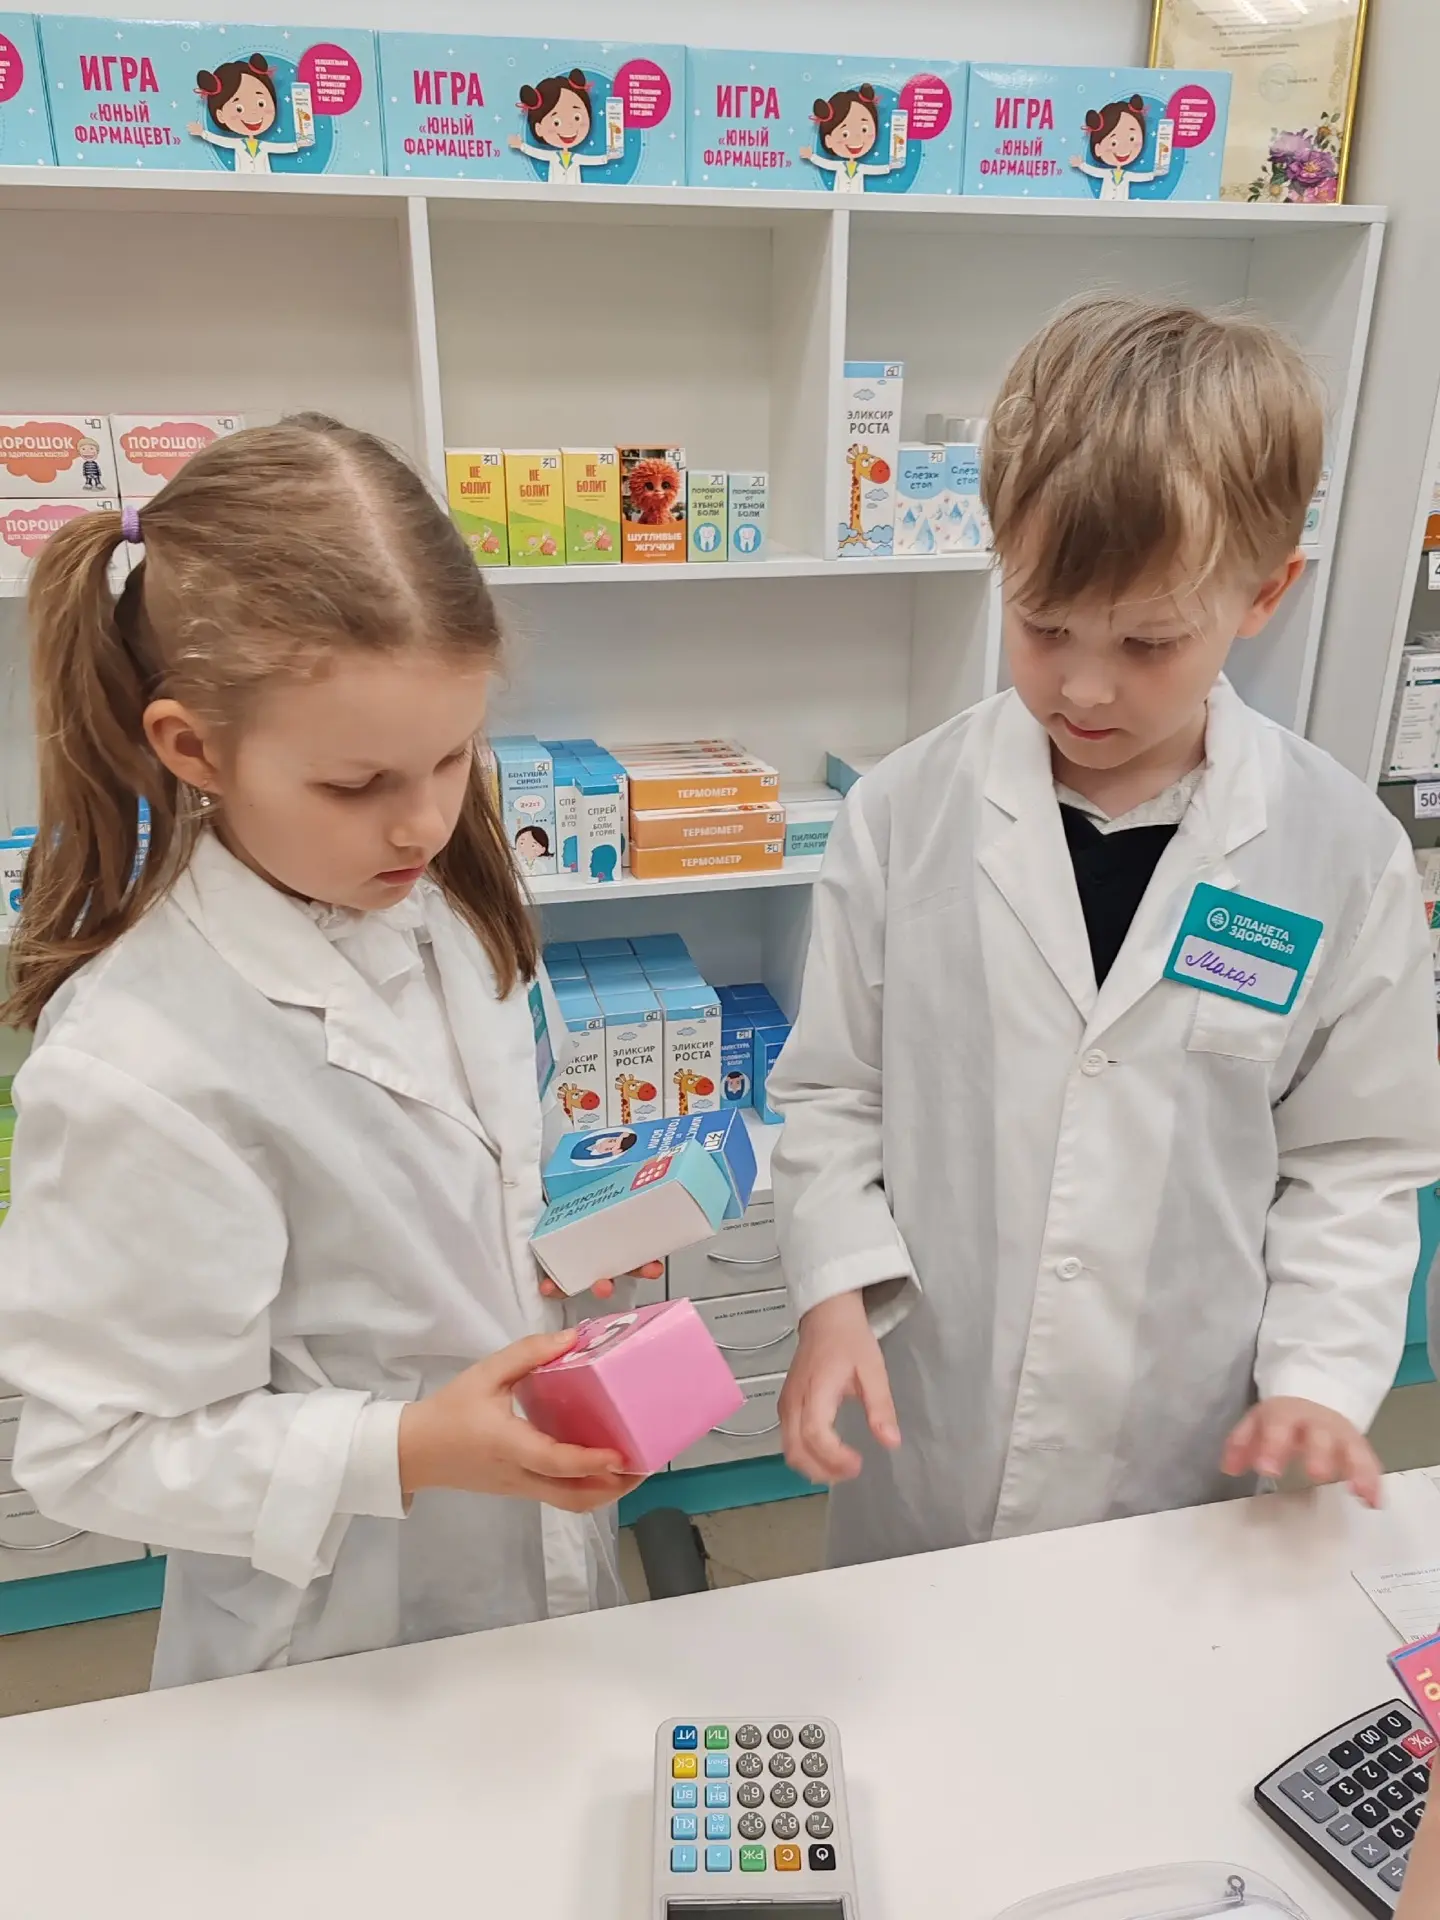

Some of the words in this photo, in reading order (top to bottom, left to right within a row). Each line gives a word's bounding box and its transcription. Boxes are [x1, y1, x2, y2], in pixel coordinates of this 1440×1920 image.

[79, 55, 159, 93] ИГРА
[413, 70, 484, 106] ИГРА
[716, 84, 780, 119] ИГРА
[89, 101, 150, 123] «ЮНЫЙ
[994, 97, 1054, 130] ИГРА
[418, 114, 474, 136] «ЮНЫЙ
[75, 125, 182, 148] ФАРМАЦЕВТ»
[718, 126, 769, 148] «ЮНЫЙ
[404, 138, 501, 160] ФАРМАЦЕВТ»
[994, 137, 1043, 157] «ЮНЫЙ
[704, 150, 792, 170] ФАРМАЦЕВТ»
[979, 159, 1063, 177] ФАРМАЦЕВТ»
[847, 410, 894, 420] ЭЛИКСИР
[850, 422, 890, 434] РОСТА
[128, 436, 206, 449] ПОРОШОК
[529, 469, 540, 481] НЕ
[585, 464, 597, 477] НЕ
[460, 481, 491, 494] БОЛИТ
[519, 484, 551, 497] БОЛИТ
[576, 480, 607, 493] БОЛИТ
[692, 501, 724, 509] ЗУБНОЙ
[732, 502, 765, 510] ЗУБНОЙ
[697, 509, 720, 517] БОЛИ
[737, 510, 760, 518] БОЛИ
[6, 519, 66, 532] ПОРОШ
[627, 532, 682, 542] ШУТЛИВЫЕ
[635, 543, 675, 552] ЖГУЧКИ
[678, 787, 738, 800] ТЕРМОМЕТР
[559, 797, 576, 806] СПР
[588, 804, 616, 815] СПРЕЙ
[683, 825, 744, 837] ТЕРМОМЕТР
[791, 832, 829, 841] ПИЛЮЛИ
[681, 855, 742, 867] ТЕРМОМЕТР
[1233, 914, 1290, 942] ПЛАНЕТА
[1228, 925, 1295, 955] ЗДОРОВЬЯ
[1185, 950, 1257, 992] Макар
[613, 1046, 655, 1057] ЭЛИКСИР
[671, 1041, 714, 1051] ЭЛИКСИР
[573, 1054, 598, 1063] КСИР
[616, 1055, 653, 1067] РОСТА
[675, 1050, 711, 1062] РОСТА
[566, 1064, 596, 1075] ОСТА
[685, 1116, 703, 1140] МИКСТ
[659, 1119, 680, 1152] ГОЛОВНО
[550, 1182, 615, 1217] ПИЛЮЛИ
[544, 1215, 562, 1226] ОТ
[563, 1186, 625, 1219] АНГИНЫ
[1416, 1667, 1440, 1718] 10
[1387, 1716, 1401, 1727] 0
[773, 1729, 789, 1739] 00
[814, 1728, 822, 1739] 0
[1360, 1729, 1380, 1745] 00
[752, 1757, 760, 1768] 3
[783, 1756, 792, 1768] 2
[818, 1757, 825, 1767] 1
[1389, 1751, 1403, 1763] 1
[1362, 1765, 1378, 1779] 2
[1414, 1771, 1426, 1783] 4
[751, 1786, 759, 1798] 6
[786, 1787, 794, 1798] 5
[819, 1787, 828, 1798] 4
[1338, 1782, 1353, 1796] 3
[1388, 1787, 1404, 1800] 5
[1362, 1804, 1376, 1816] 6
[754, 1817, 763, 1828] 9
[789, 1817, 797, 1828] 8
[821, 1817, 829, 1828] 7
[1391, 1826, 1405, 1839] 9
